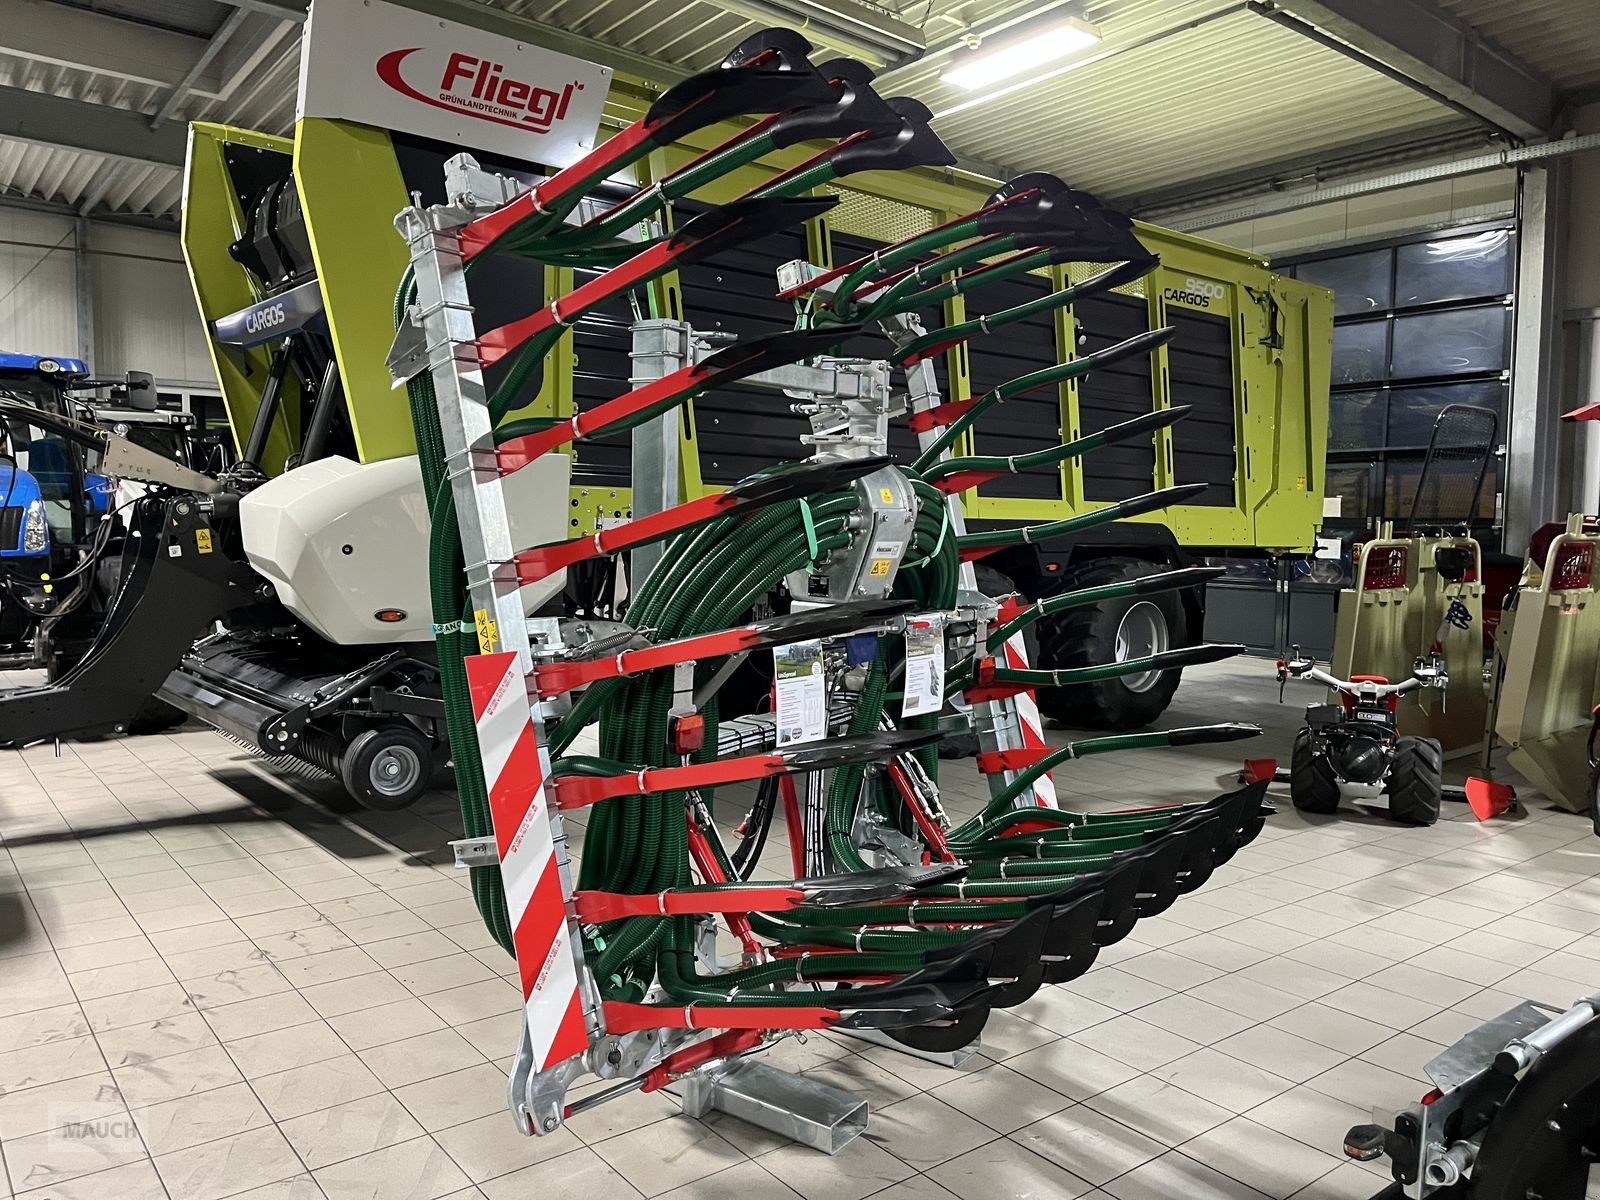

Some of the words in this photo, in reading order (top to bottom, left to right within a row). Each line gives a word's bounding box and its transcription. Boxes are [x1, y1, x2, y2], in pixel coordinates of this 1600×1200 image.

[440, 52, 575, 127] Fliegl
[439, 93, 518, 119] GRÜNLANDTECHNIK
[1164, 287, 1210, 308] CARGOS
[1185, 278, 1225, 299] 9500
[245, 302, 285, 334] CARGOS
